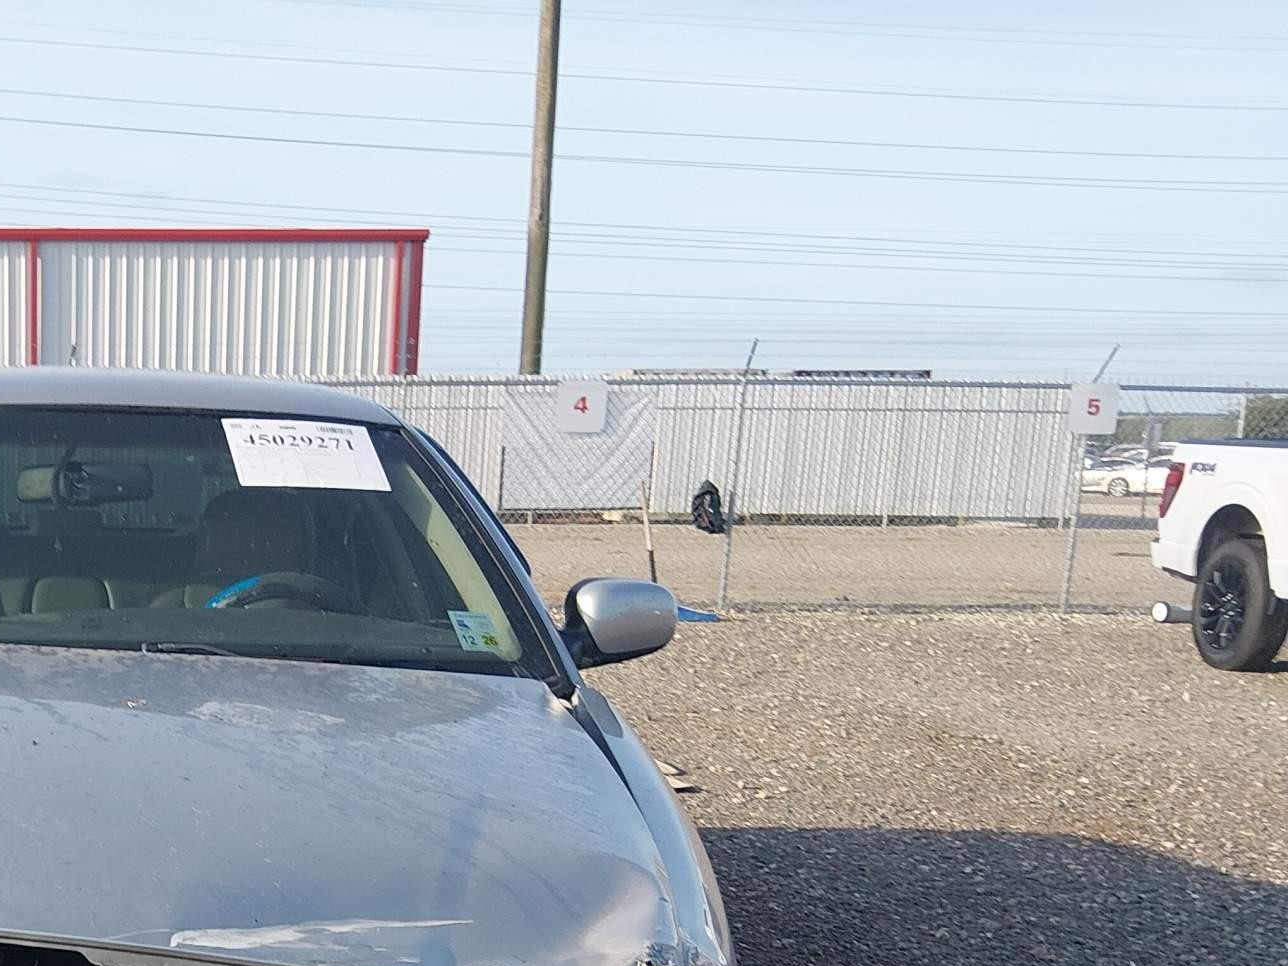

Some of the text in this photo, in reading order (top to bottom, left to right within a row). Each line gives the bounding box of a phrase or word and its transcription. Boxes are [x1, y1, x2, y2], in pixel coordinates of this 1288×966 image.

[574, 396, 590, 414] 4
[1087, 399, 1101, 416] 5
[243, 433, 355, 451] 45029271
[462, 633, 499, 646] 12 26
